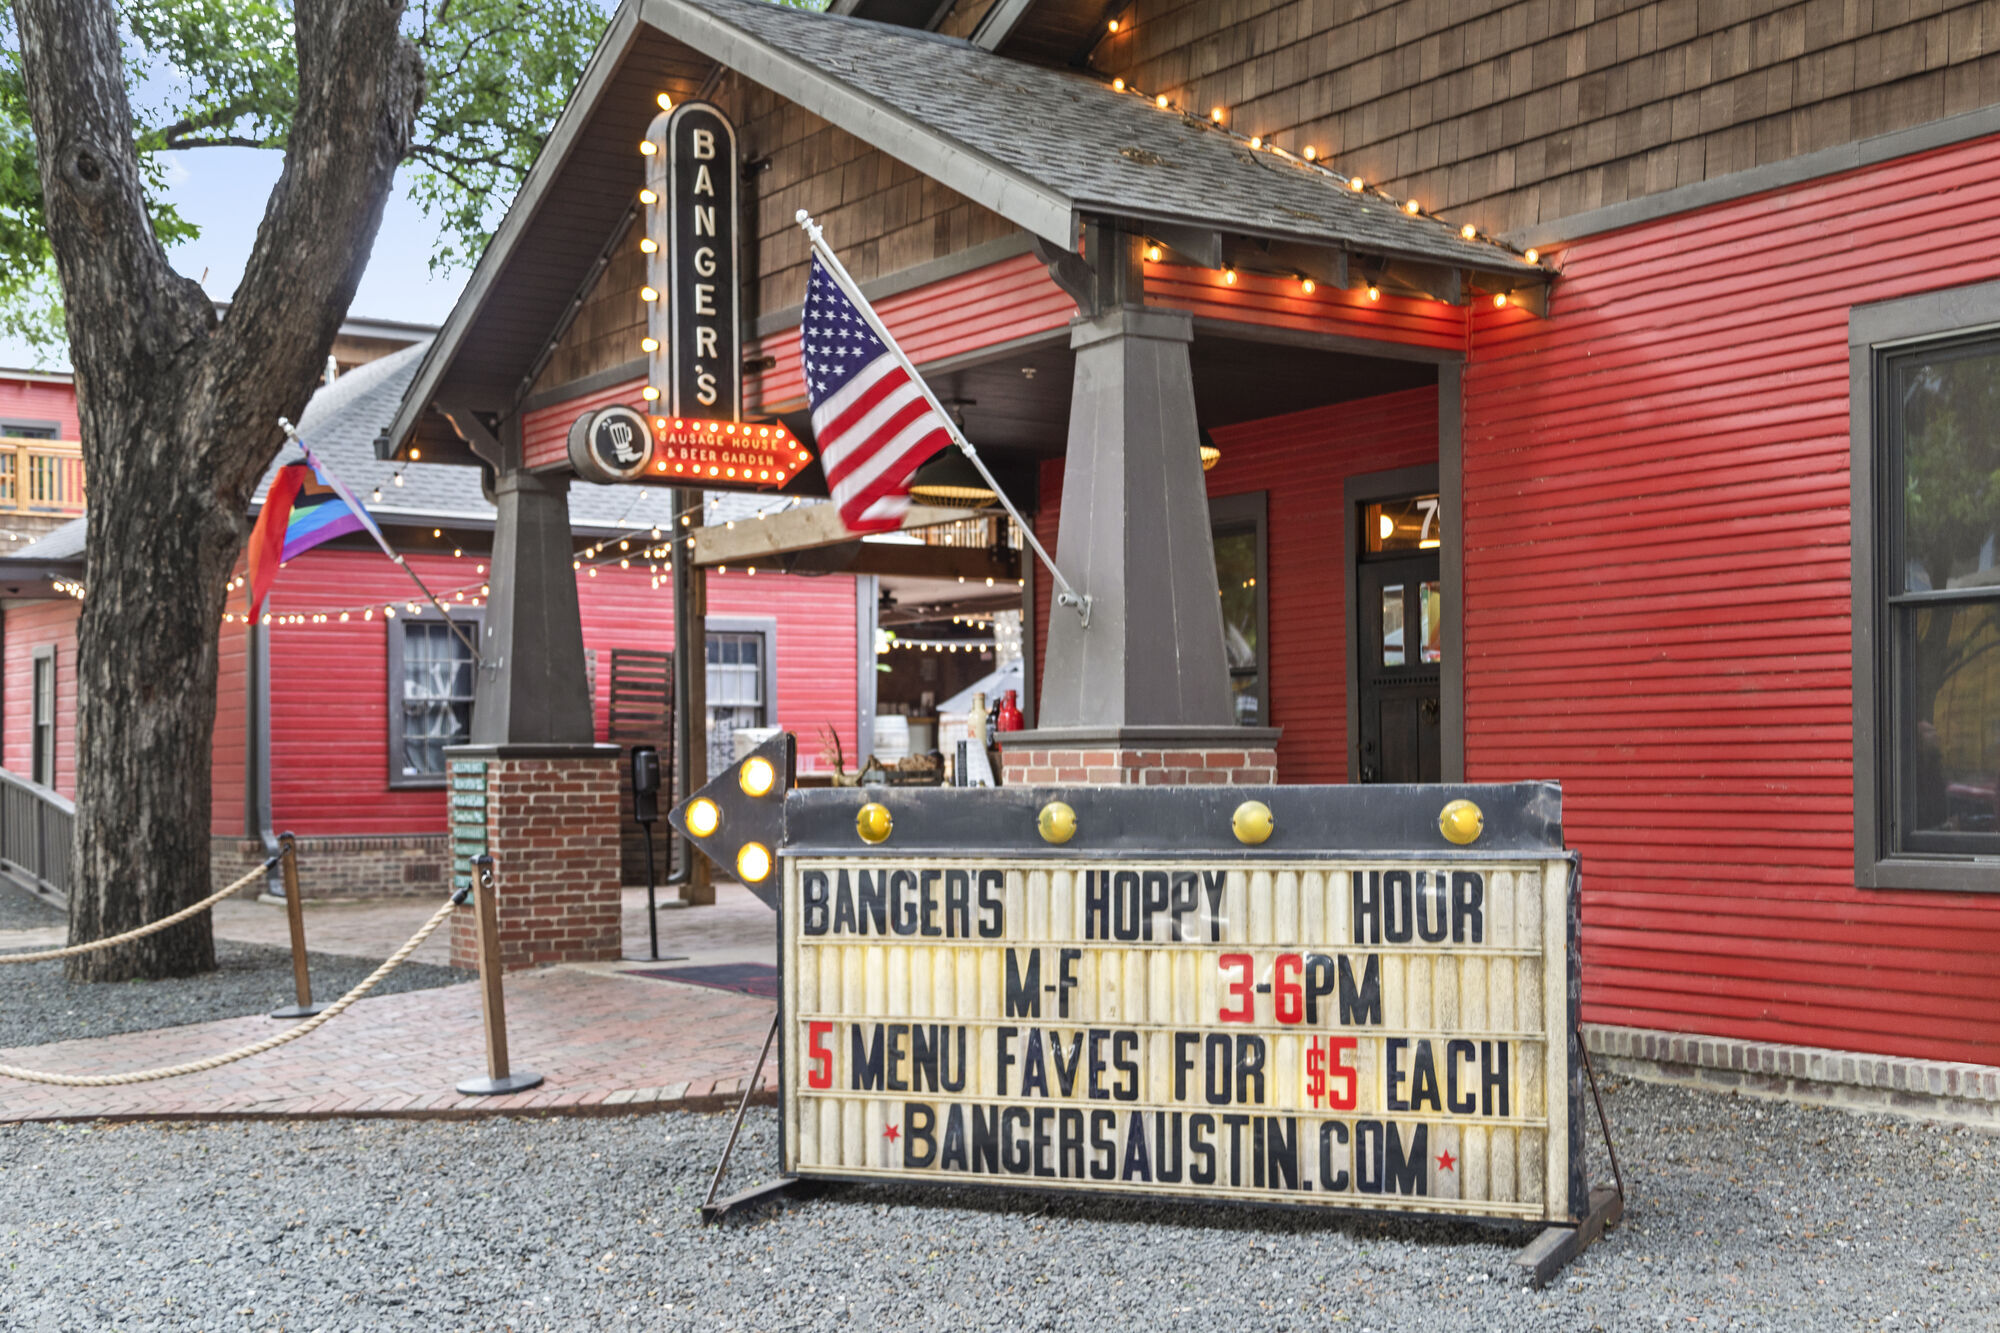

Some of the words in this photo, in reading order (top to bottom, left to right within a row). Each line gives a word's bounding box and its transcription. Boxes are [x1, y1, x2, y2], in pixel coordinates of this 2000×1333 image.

[693, 128, 718, 406] BANGER'S
[659, 431, 724, 446] SAUSAGE
[732, 437, 778, 450] HOUSE
[667, 448, 675, 459] &
[681, 448, 716, 461] BEER
[722, 453, 774, 466] GARDEN
[1417, 499, 1440, 540] 7
[803, 869, 1004, 938] BANGER'S
[1085, 870, 1226, 942] HOPPY
[1353, 870, 1484, 944] HOUR
[1005, 948, 1082, 1018] M-F
[1218, 953, 1382, 1025] 3-6PM
[808, 1021, 833, 1089] 5
[851, 1023, 966, 1092] MENU
[997, 1027, 1139, 1100] FAVES
[1174, 1032, 1266, 1104] FOR
[1306, 1035, 1358, 1111] $5
[1386, 1037, 1510, 1117] EACH
[904, 1103, 1429, 1196] BANGERSAUSTIN.COM
